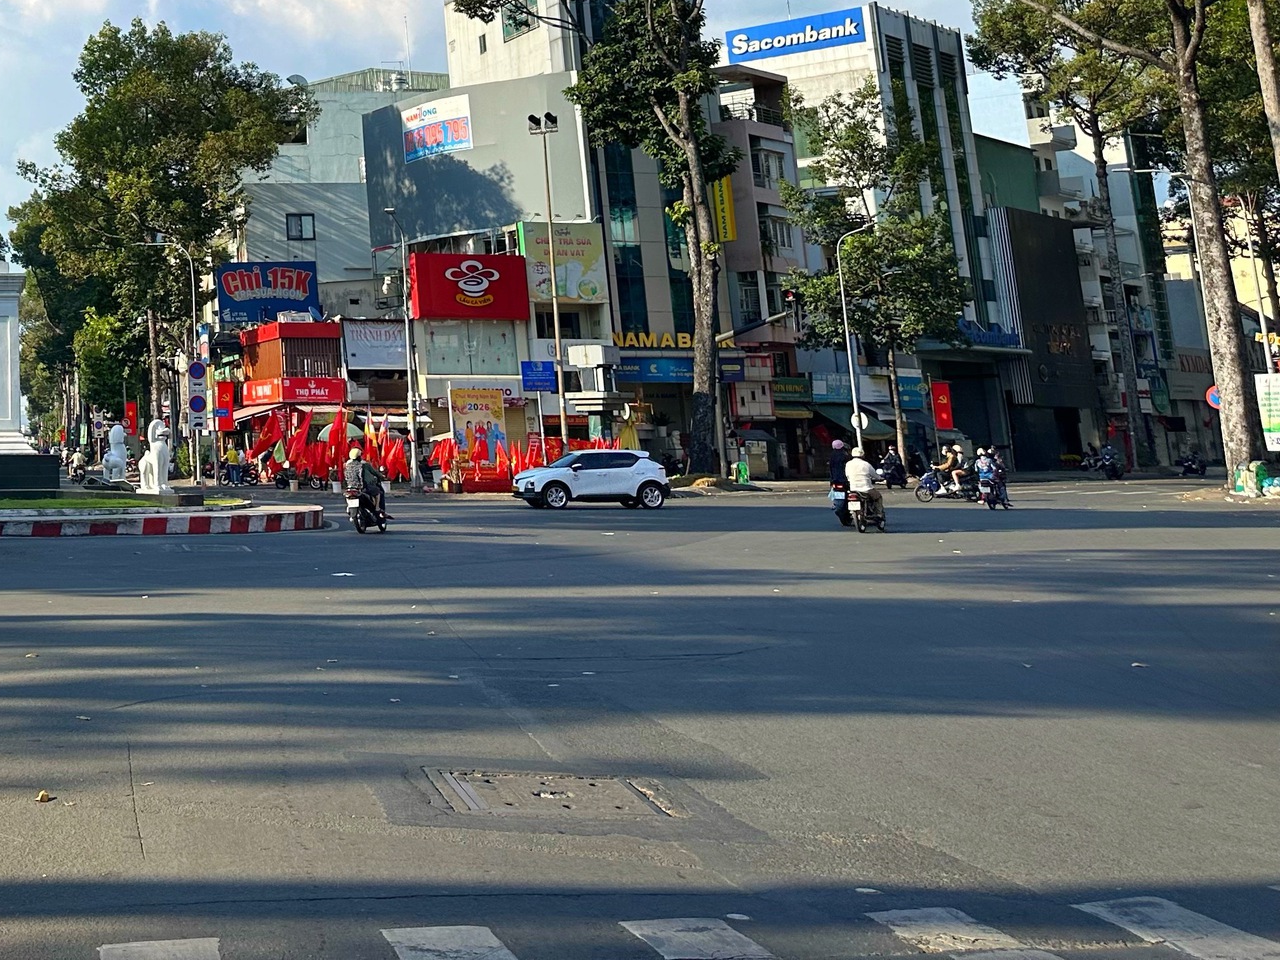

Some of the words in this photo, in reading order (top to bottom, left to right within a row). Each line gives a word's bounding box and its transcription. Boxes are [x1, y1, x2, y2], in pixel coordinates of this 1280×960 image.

[731, 17, 859, 56] Sacombank
[222, 266, 262, 297] Chỉ
[267, 267, 312, 296] 15K
[612, 331, 658, 348] NAM
[661, 332, 676, 348] A
[295, 388, 309, 397] THỌ
[311, 387, 329, 396] PHÁT
[467, 403, 490, 411] 2026
